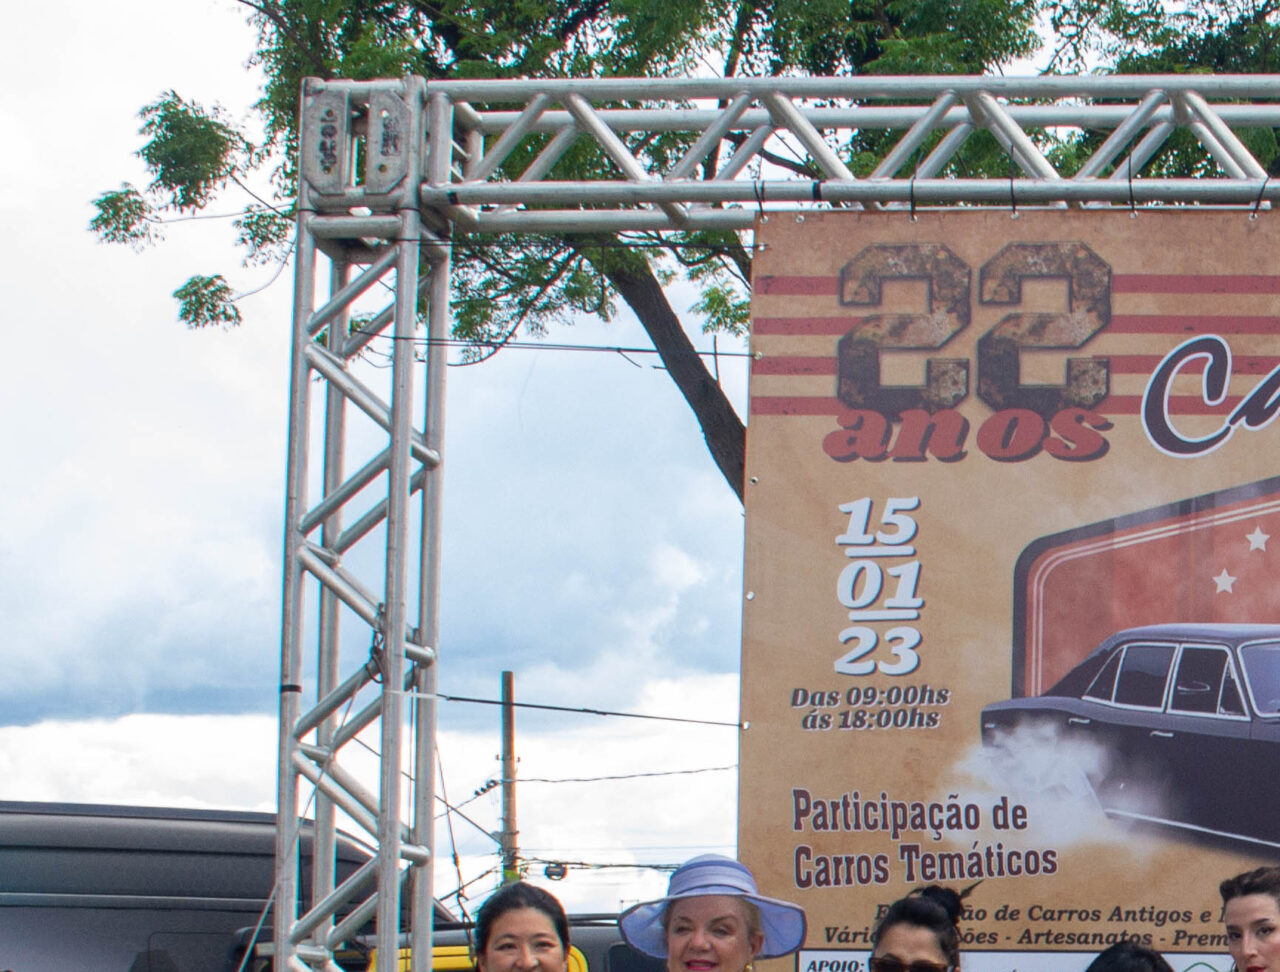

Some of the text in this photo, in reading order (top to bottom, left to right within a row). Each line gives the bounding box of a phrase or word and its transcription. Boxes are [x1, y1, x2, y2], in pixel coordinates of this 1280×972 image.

[837, 242, 1112, 415] 22
[822, 408, 1114, 463] anos
[835, 496, 920, 547] 15
[837, 559, 924, 609] 01
[834, 625, 923, 676] 23
[790, 684, 952, 708] Das 09:00hs
[838, 707, 941, 731] 18:00hs
[792, 788, 1028, 841] Participação de
[793, 841, 1059, 889] Carros Temáticos
[994, 904, 1020, 922] de
[1027, 904, 1101, 922] Carros
[1107, 906, 1193, 927] Antigos
[1200, 910, 1212, 923] e
[1017, 928, 1152, 946] Artesanatos
